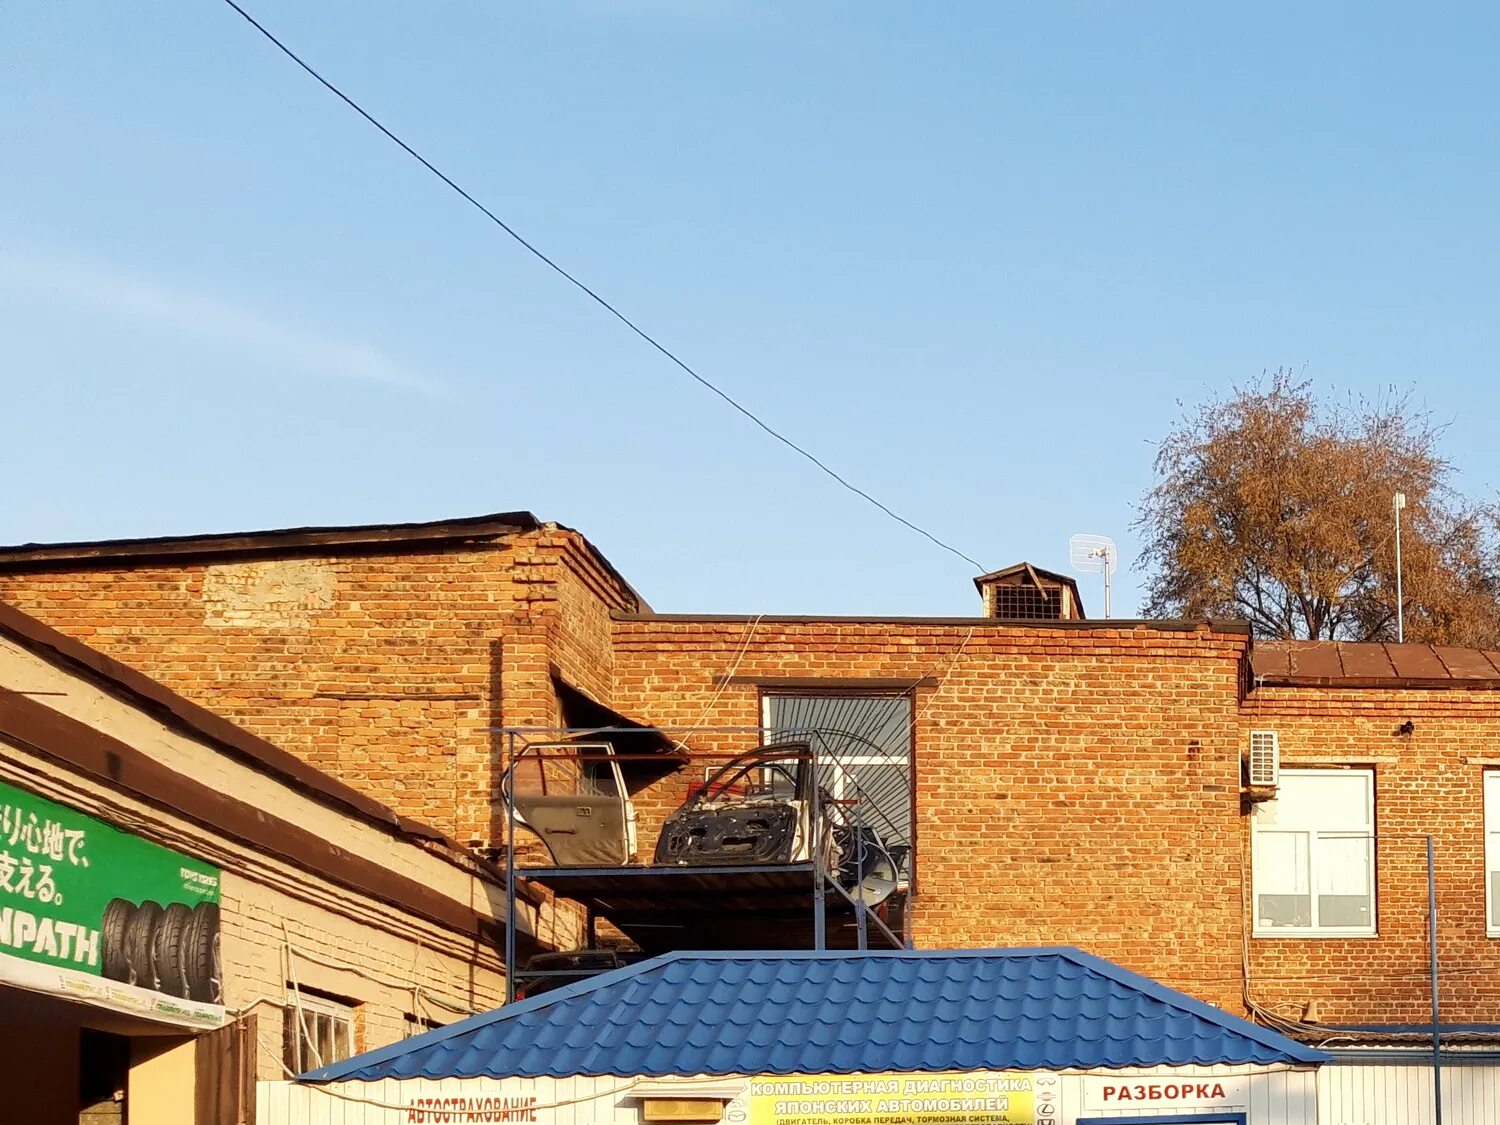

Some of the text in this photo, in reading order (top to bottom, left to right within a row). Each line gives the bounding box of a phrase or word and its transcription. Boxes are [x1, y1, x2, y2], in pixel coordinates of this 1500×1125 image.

[751, 1078, 1033, 1096] КОМПЬЮТЕРНАЯ ДИАГНОСТИКА
[1102, 1083, 1225, 1101] РАЗБОРКА
[408, 1097, 537, 1123] АВТОСТРАХОВАНИЕ
[775, 1096, 1008, 1114] ЯПОНСКИХ АВТОМОБИЛЕЙ
[833, 1117, 871, 1125] КОРОБКА
[874, 1115, 915, 1125] ПЕРЕДАЧ,
[917, 1115, 966, 1123] ТОРМОЗНАЯ
[969, 1114, 1009, 1122] СИСТЕМА,
